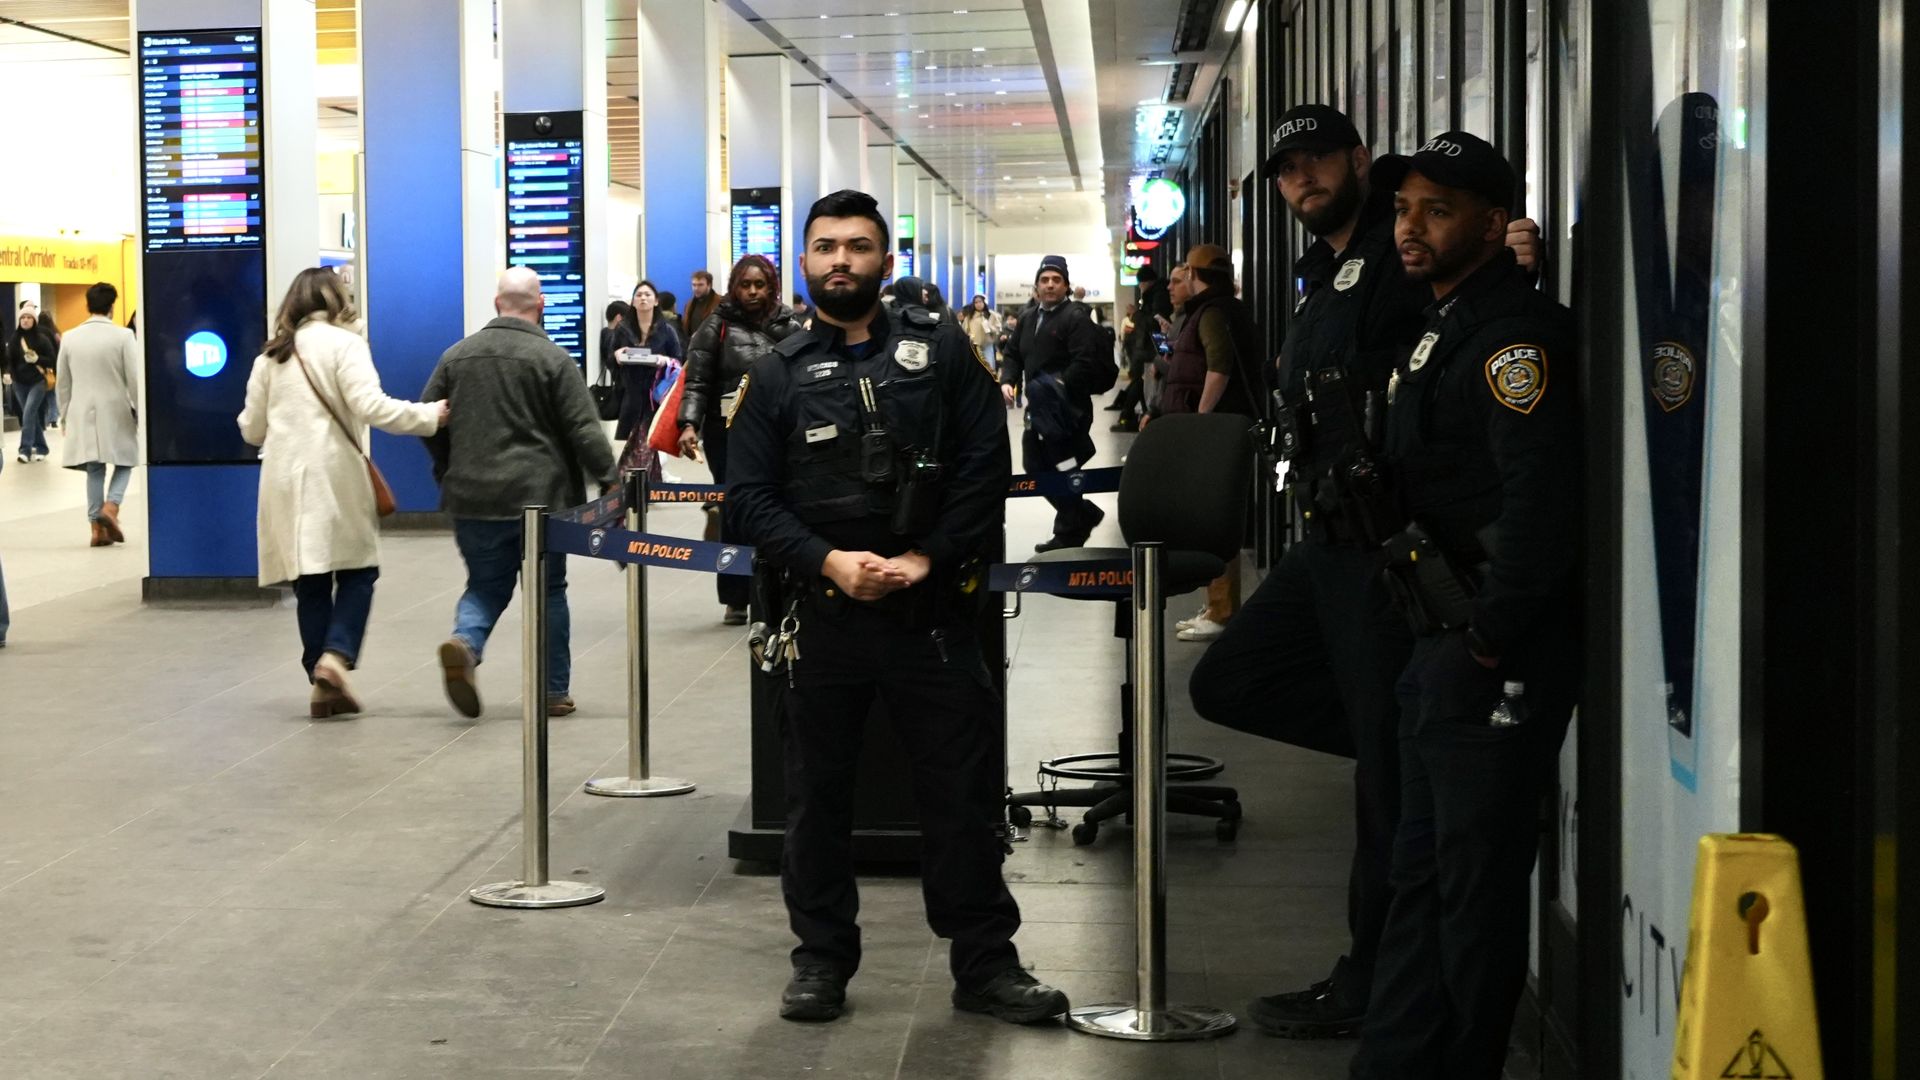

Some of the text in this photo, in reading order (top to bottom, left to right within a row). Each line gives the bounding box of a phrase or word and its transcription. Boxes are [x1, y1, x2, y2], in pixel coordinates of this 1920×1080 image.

[1272, 117, 1318, 148] MTAPD
[570, 156, 580, 165] 17
[23, 246, 56, 269] Corridor
[185, 341, 221, 369] MTA
[1490, 348, 1540, 376] POLICE
[649, 489, 726, 503] MTA POLICE
[627, 540, 693, 562] MTA POLICE
[1067, 571, 1097, 587] MTA
